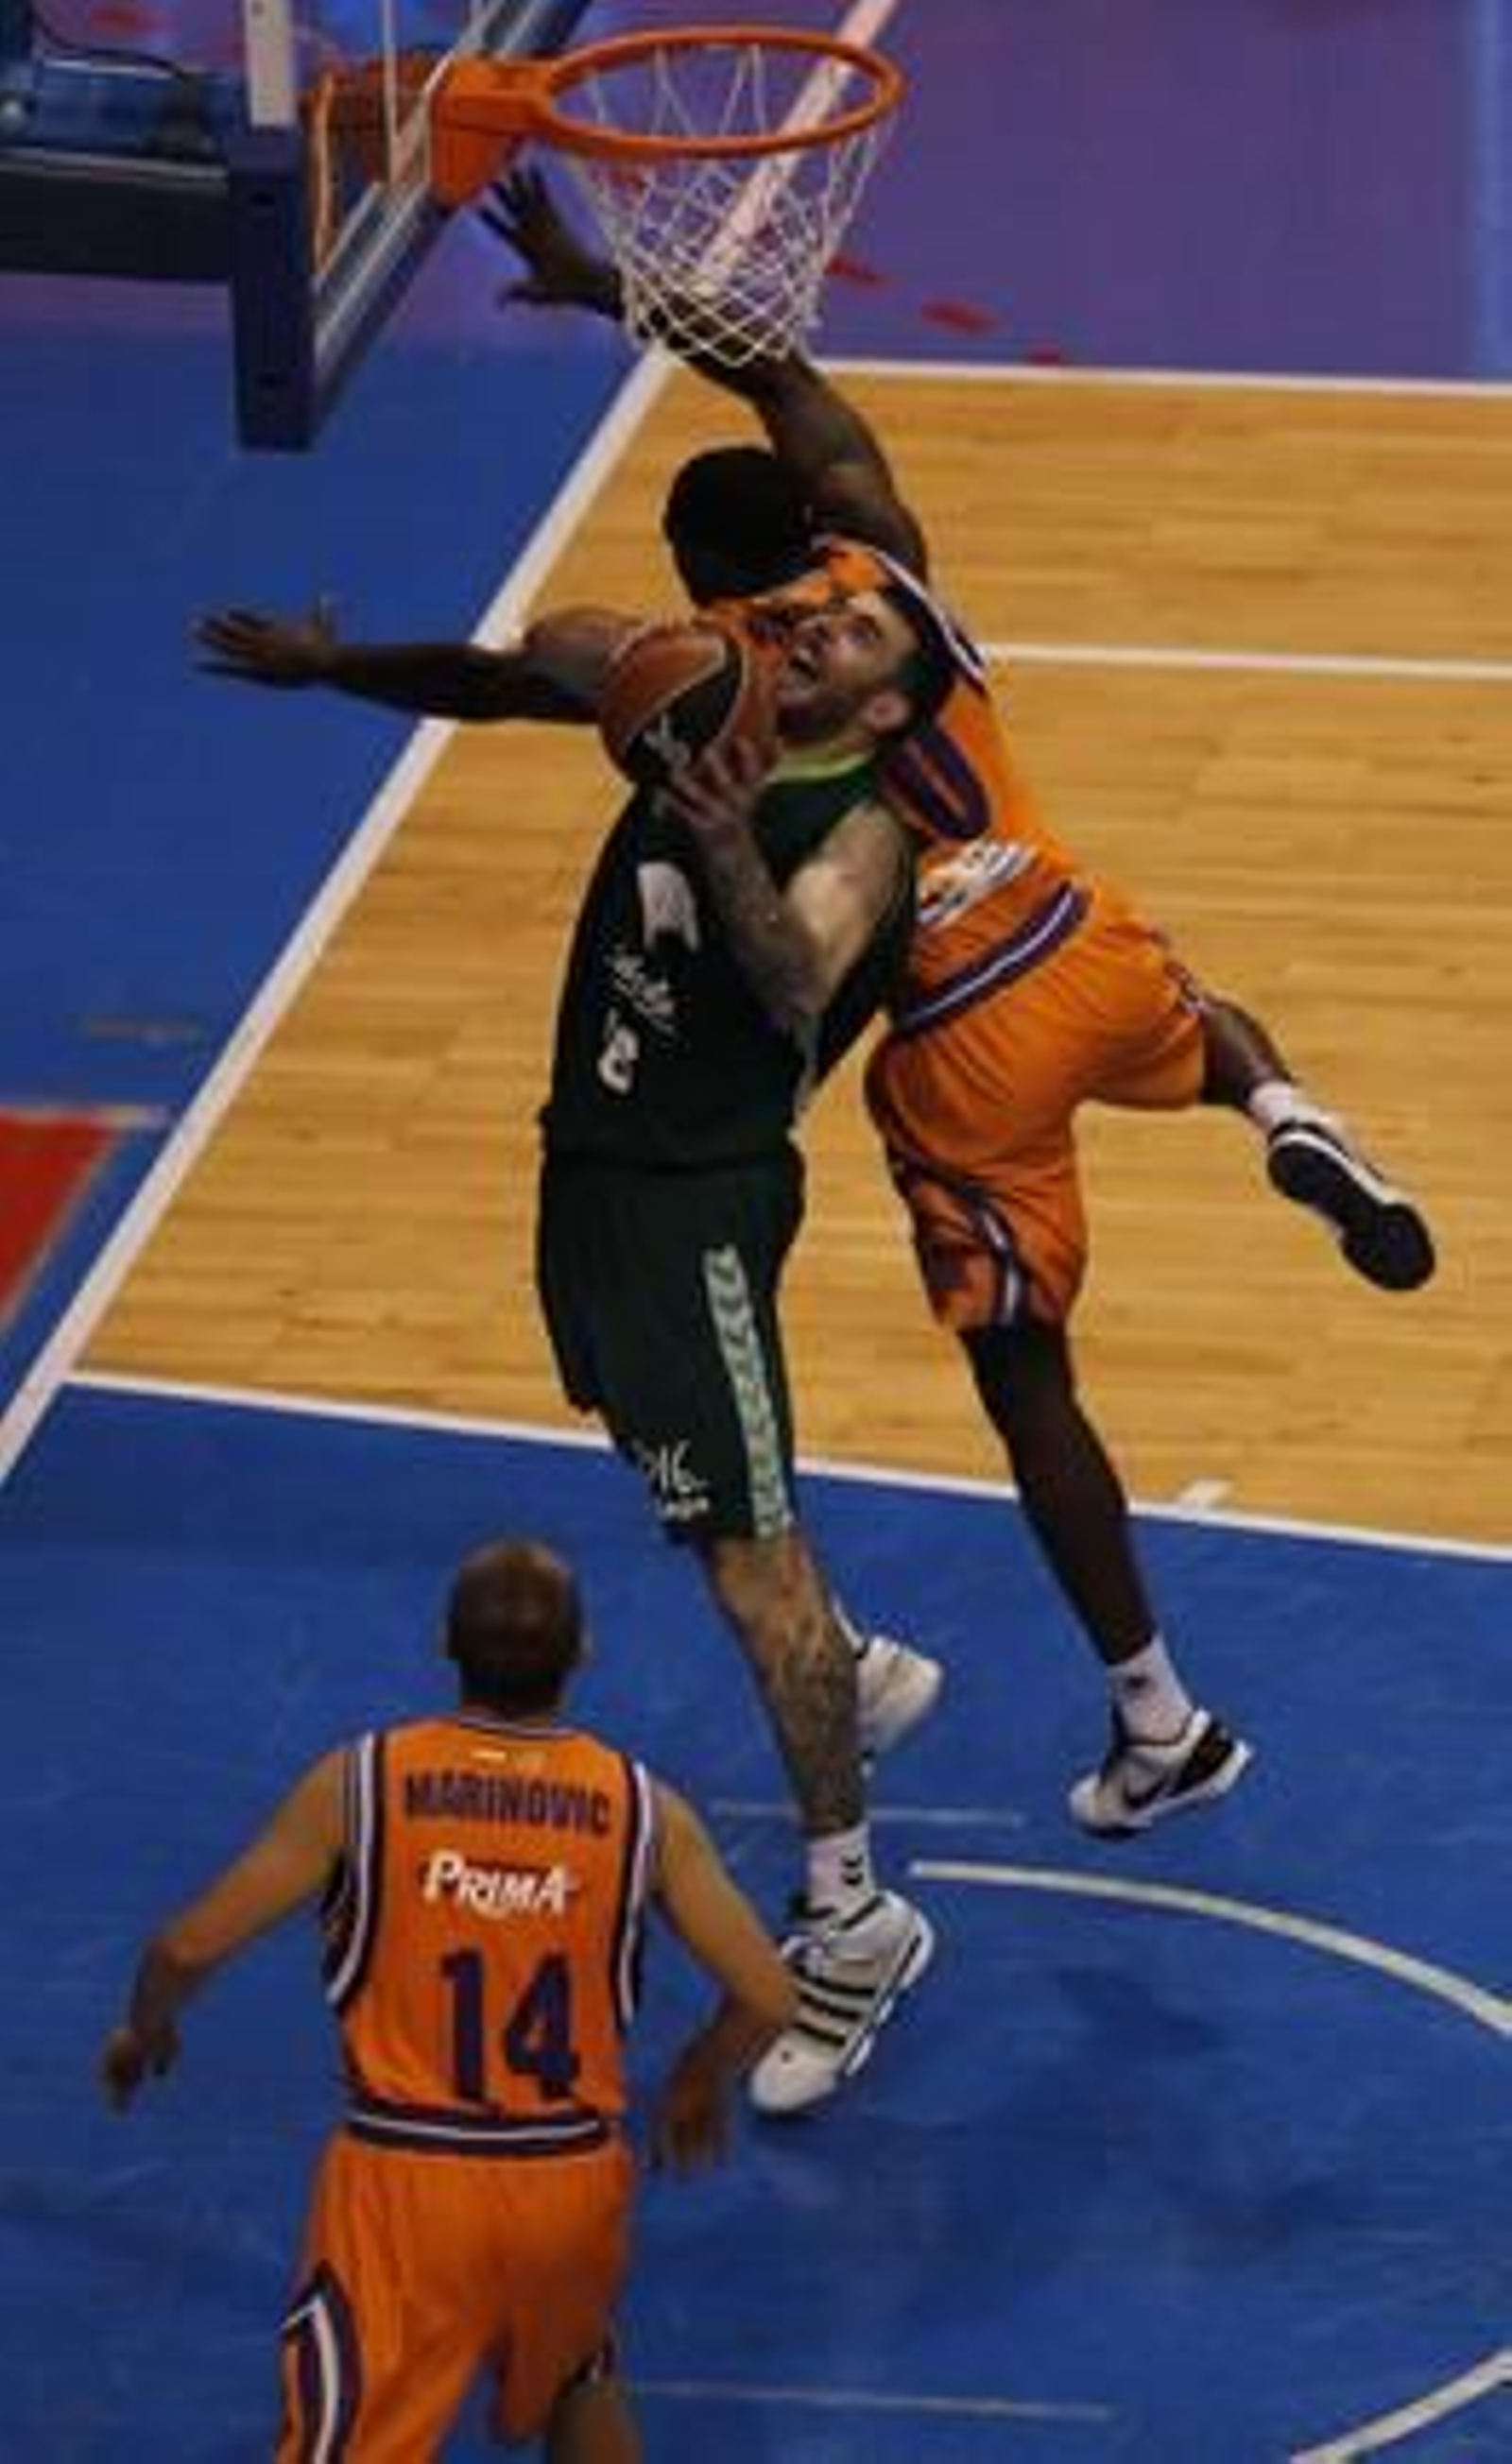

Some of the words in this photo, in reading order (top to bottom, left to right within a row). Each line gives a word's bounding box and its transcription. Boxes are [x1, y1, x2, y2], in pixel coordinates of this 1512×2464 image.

[404, 1771, 611, 1838] MARINOVIC
[424, 1849, 568, 1920] PRIMA
[441, 1948, 580, 2099] 14
